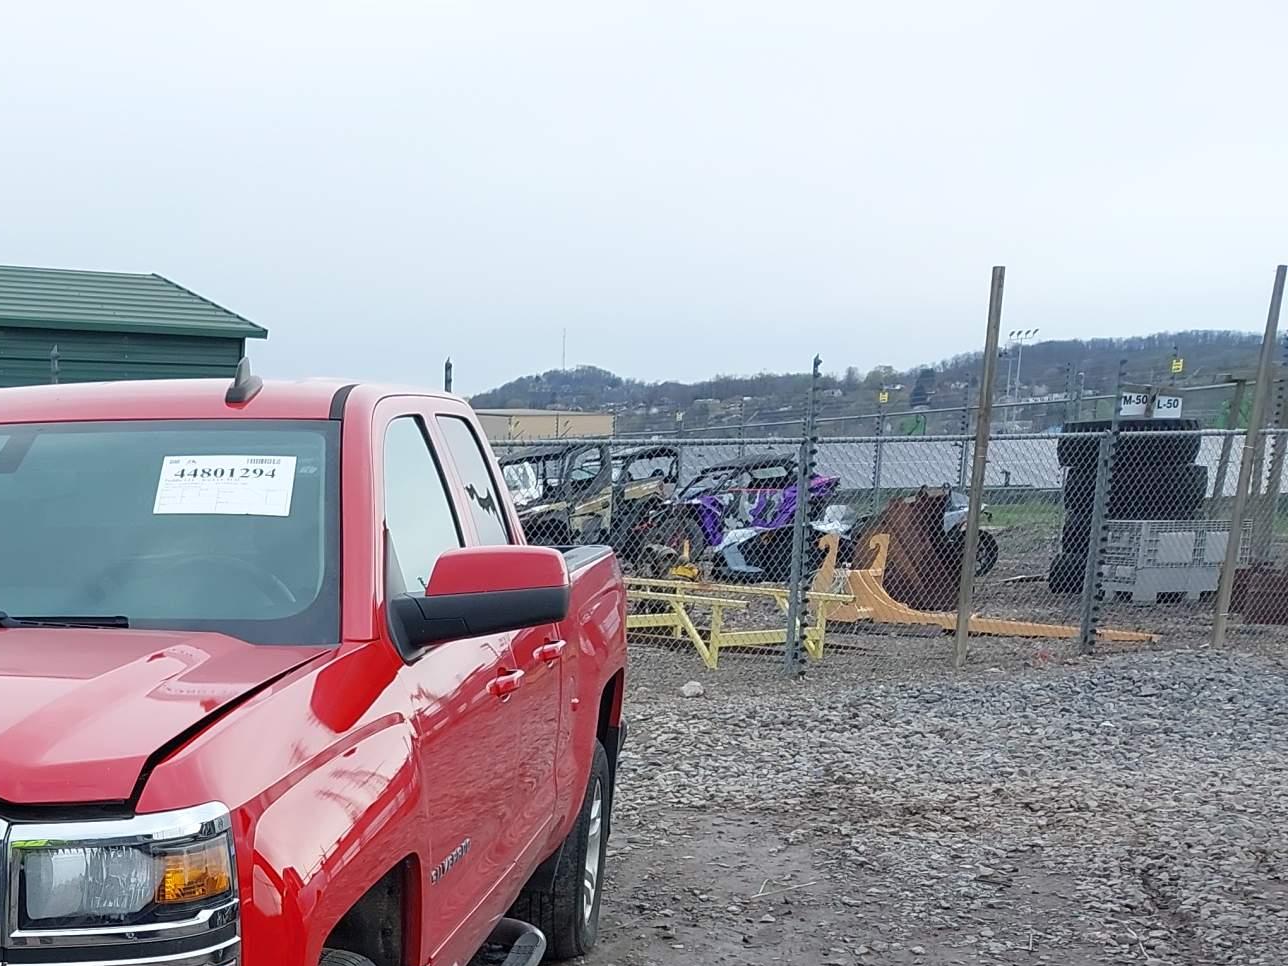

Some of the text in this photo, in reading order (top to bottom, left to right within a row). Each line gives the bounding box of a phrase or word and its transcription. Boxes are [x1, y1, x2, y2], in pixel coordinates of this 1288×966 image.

[1123, 395, 1148, 405] M-50
[1157, 399, 1178, 409] L-50
[174, 467, 276, 478] 44801294
